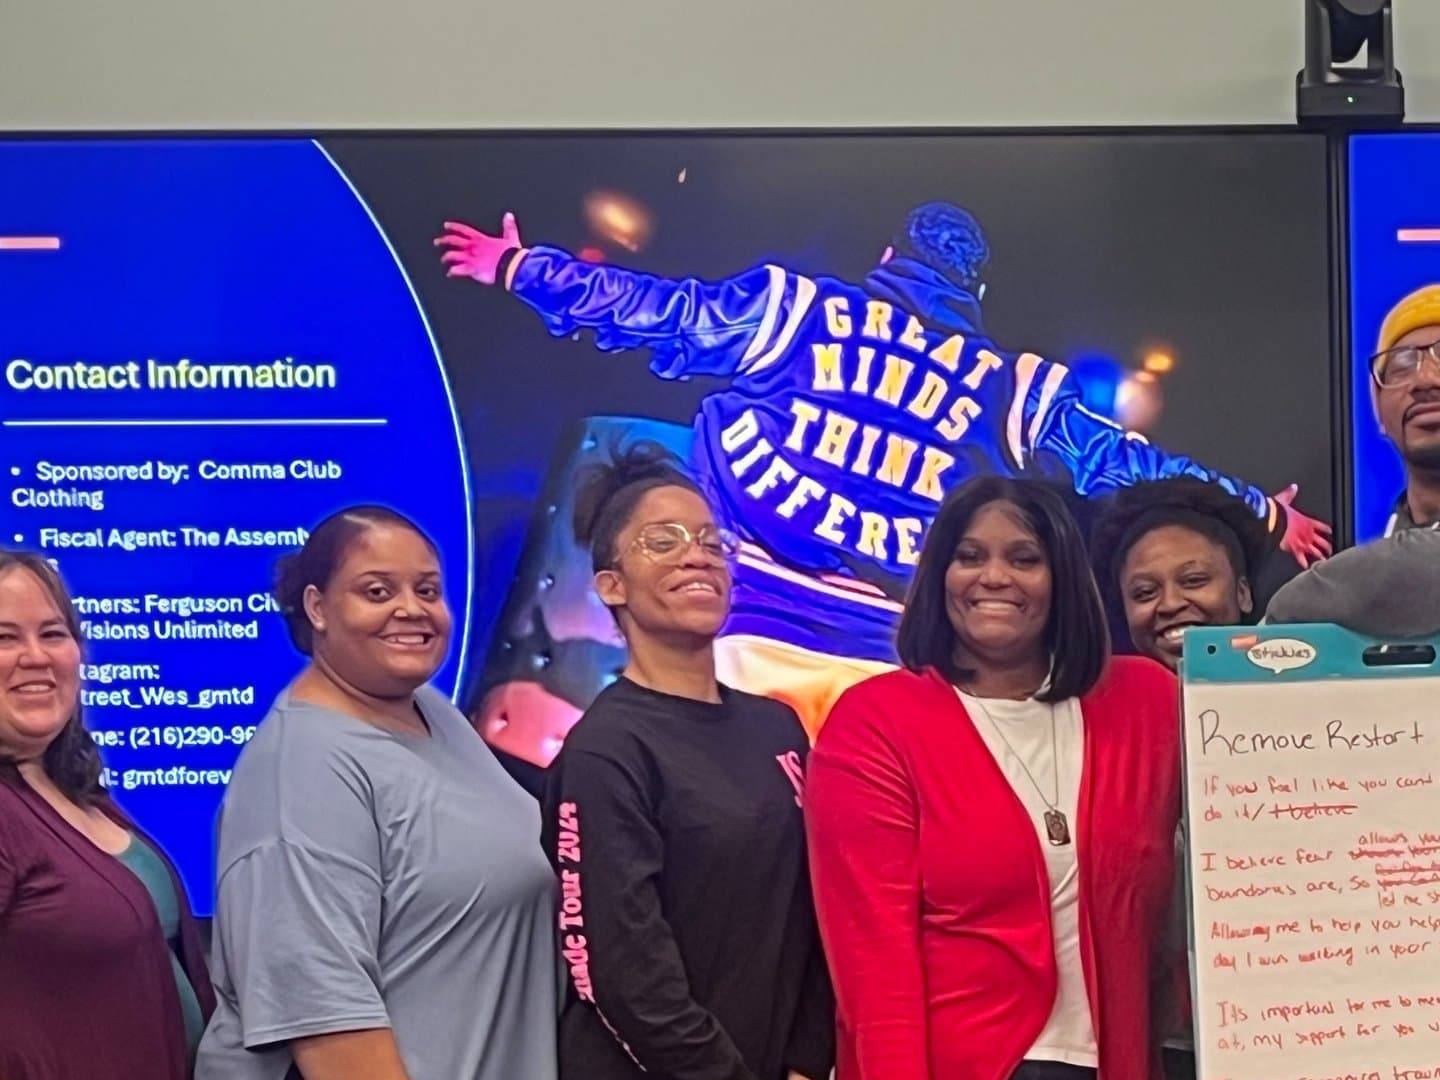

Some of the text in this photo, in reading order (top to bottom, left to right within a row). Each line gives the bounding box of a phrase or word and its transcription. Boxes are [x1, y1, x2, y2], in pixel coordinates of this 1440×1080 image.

[824, 297, 1002, 389] GREAT
[6, 357, 336, 389] Contact Information
[812, 343, 982, 440] MINDS
[784, 397, 955, 501] THINK
[36, 459, 342, 485] Sponsored by: Comma Club
[11, 487, 104, 511] Clothing
[721, 409, 923, 566] DIFFERE
[40, 528, 104, 548] Fiscal
[107, 528, 176, 551] Agent:
[181, 528, 220, 546] The
[145, 594, 243, 616] Ferguson
[154, 619, 258, 639] Unlimited
[79, 663, 159, 684] tagram:
[81, 686, 254, 709] treet_Wes_gmtd
[130, 725, 257, 749] (216)290-96
[1199, 709, 1315, 756] Remove
[1326, 719, 1425, 751] Restart
[123, 766, 232, 790] gmtdforev
[1226, 782, 1258, 797] you
[1313, 778, 1349, 791] like
[1359, 778, 1388, 792] you
[1205, 806, 1222, 822] do
[559, 869, 584, 930] Tour
[1276, 921, 1301, 933] me
[1310, 918, 1324, 932] to
[1371, 918, 1400, 933] you
[1365, 944, 1380, 954] in
[1399, 995, 1412, 1007] to
[1253, 1033, 1283, 1049] my
